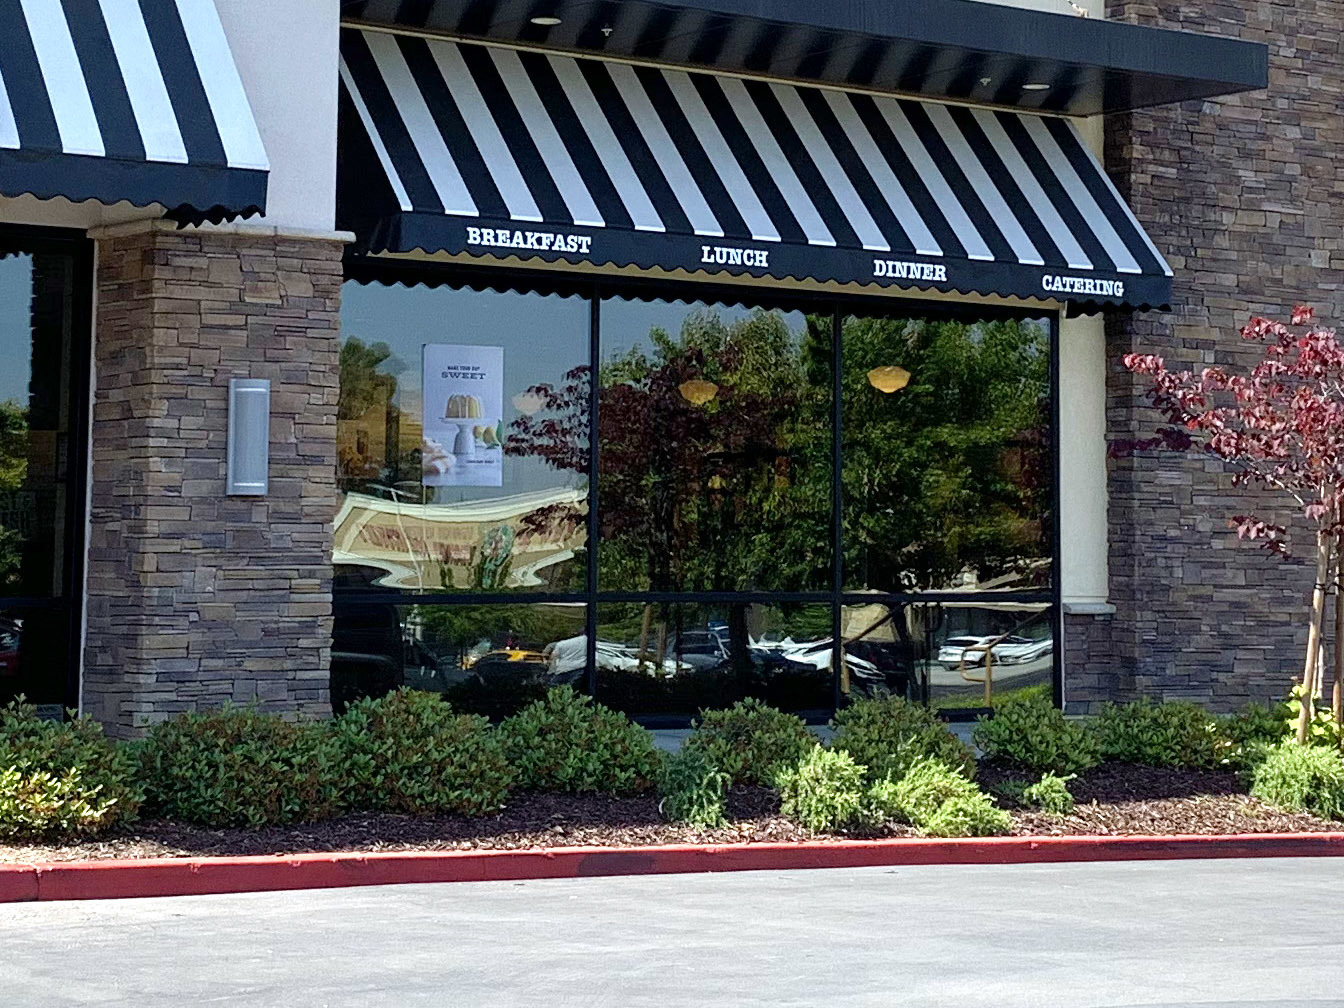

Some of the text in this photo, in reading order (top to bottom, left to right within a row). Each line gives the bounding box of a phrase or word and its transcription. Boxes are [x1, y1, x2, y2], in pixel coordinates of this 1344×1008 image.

[466, 227, 1125, 297] BREAKFAST LUNCH DINNER CATERING
[441, 371, 486, 380] SWEET
